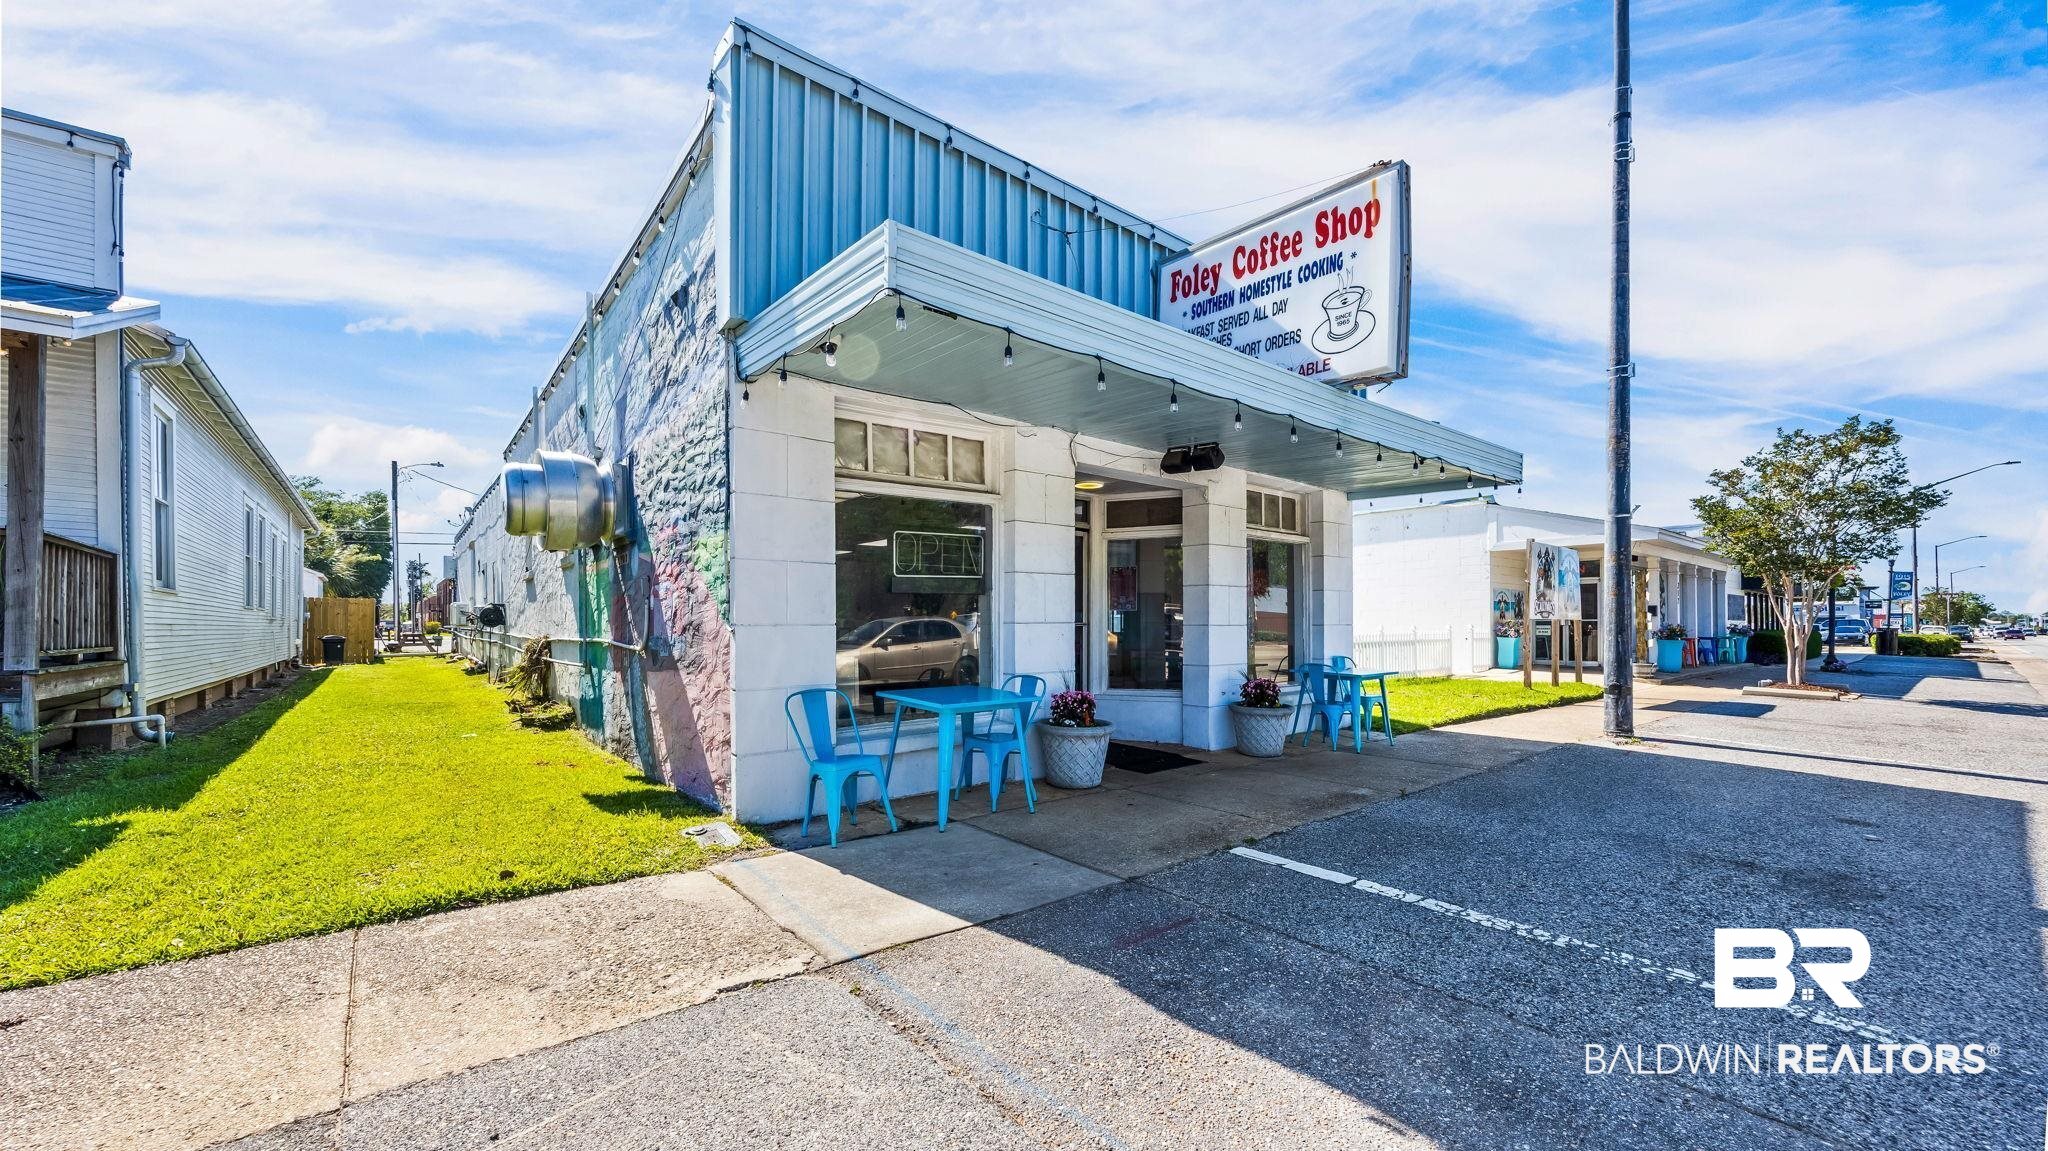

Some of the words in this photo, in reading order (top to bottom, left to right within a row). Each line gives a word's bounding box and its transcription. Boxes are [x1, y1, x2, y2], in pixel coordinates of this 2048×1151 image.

[1170, 263, 1222, 303] Foley
[1233, 230, 1303, 279] Coffee
[1315, 198, 1381, 248] Shop
[1191, 289, 1235, 320] SOUTHERN
[1240, 273, 1292, 305] HOMESTYLE
[1298, 251, 1344, 284] COOKING
[1218, 310, 1250, 334] SERVED
[1253, 308, 1269, 323] ALL
[1272, 298, 1289, 317] DAY
[1335, 311, 1352, 321] SINCE
[1265, 329, 1302, 353] ORDERS
[897, 532, 982, 575] OPEN
